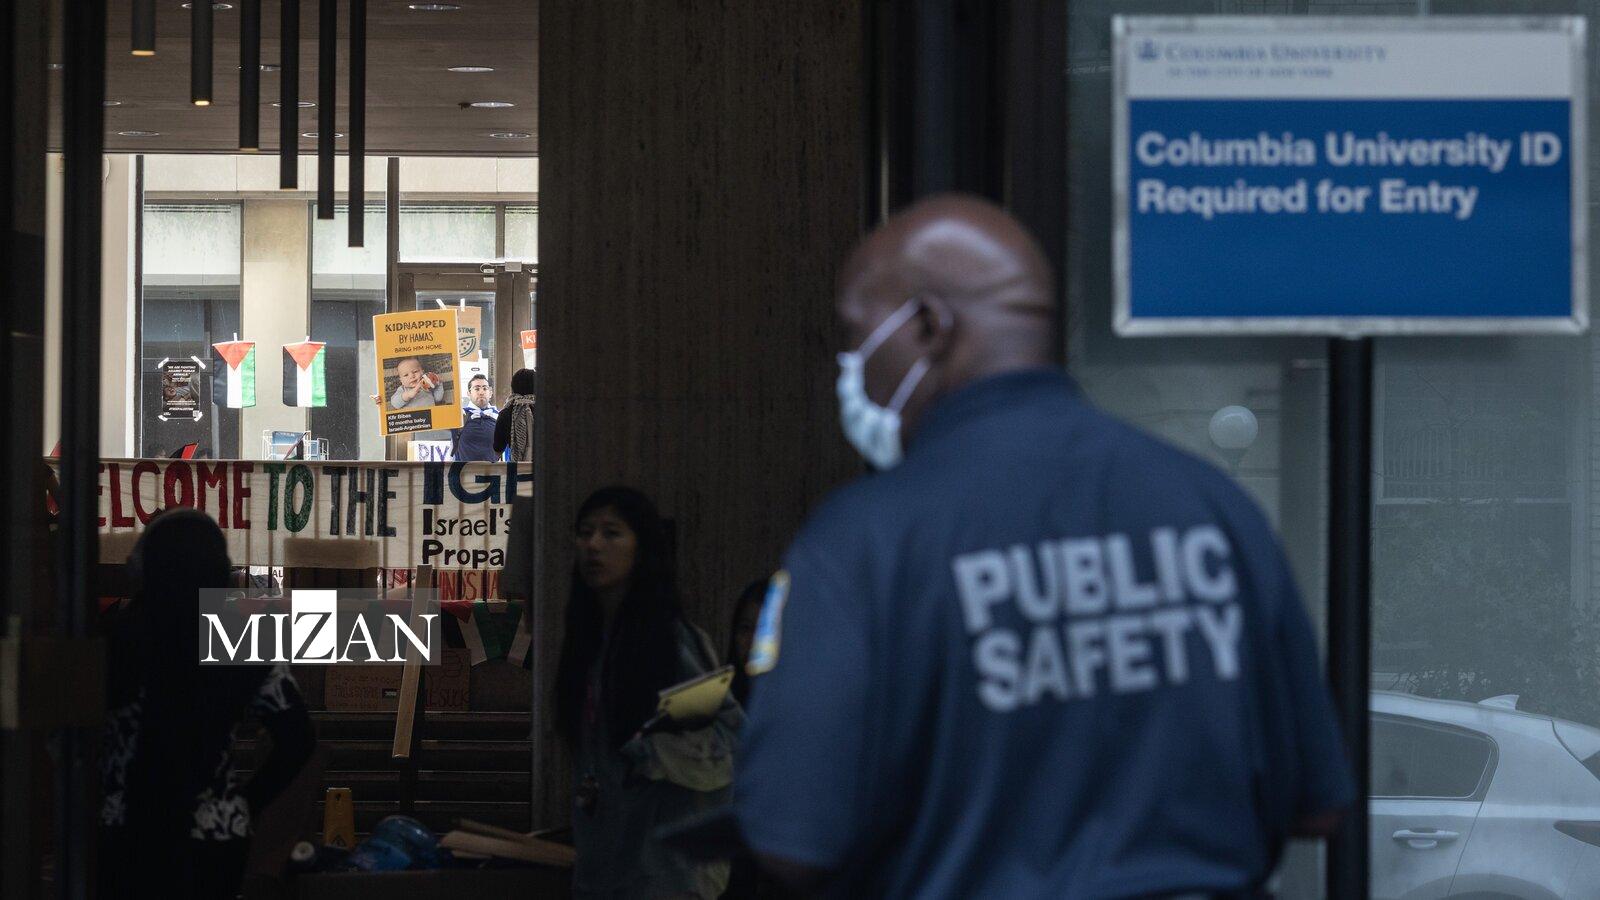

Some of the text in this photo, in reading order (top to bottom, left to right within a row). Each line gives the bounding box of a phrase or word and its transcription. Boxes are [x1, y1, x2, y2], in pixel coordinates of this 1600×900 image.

[1136, 131, 1562, 174] Columbia University ID
[1137, 178, 1480, 221] Required for Entry
[385, 320, 446, 333] KIDNAPPED
[399, 332, 434, 344] BY HAMAS
[97, 461, 397, 537] LCOME TO THE
[422, 539, 505, 569] Propa
[954, 524, 1238, 634] PUBLIC
[974, 602, 1242, 711] SAFETY
